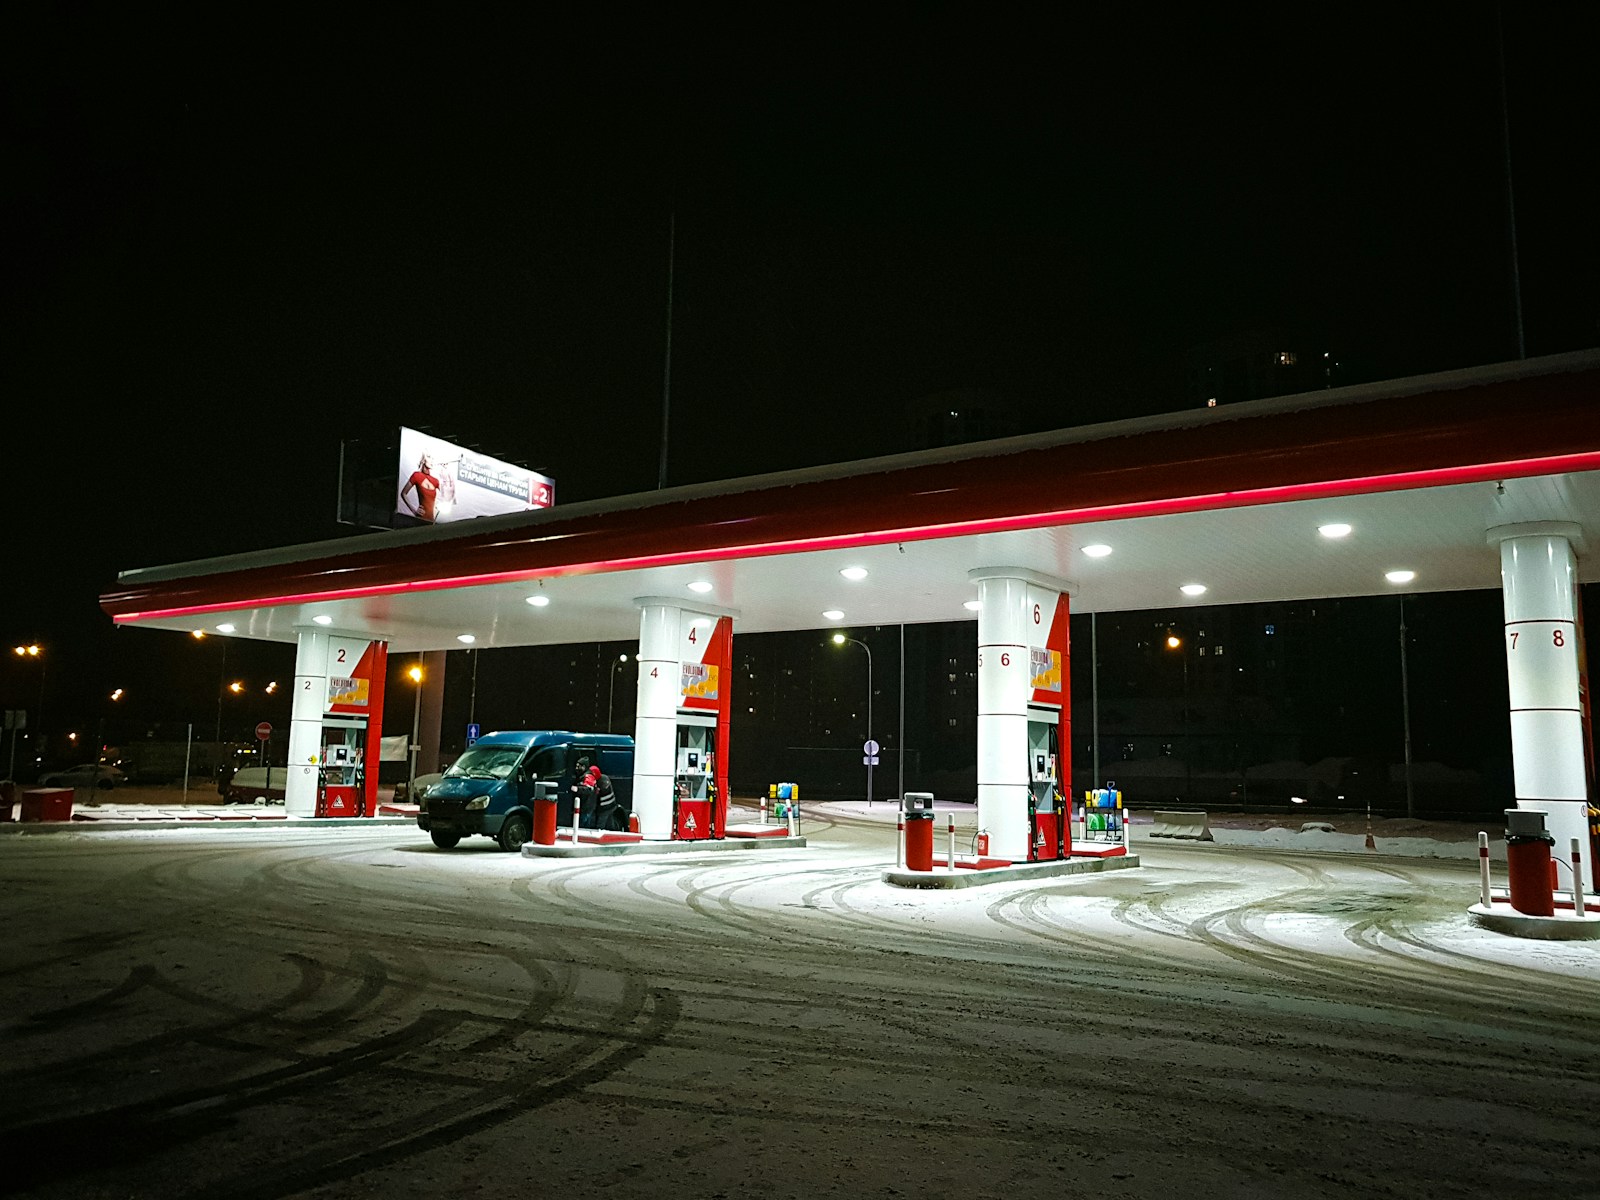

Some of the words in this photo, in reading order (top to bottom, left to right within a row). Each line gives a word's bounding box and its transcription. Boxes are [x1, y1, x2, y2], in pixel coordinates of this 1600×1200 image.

[1034, 604, 1041, 625] 6
[688, 627, 696, 644] 4
[1510, 632, 1519, 650] 7
[1553, 629, 1565, 647] 8
[337, 648, 346, 663] 2
[1001, 653, 1010, 667] 6
[650, 667, 658, 679] 4
[304, 681, 311, 690] 2
